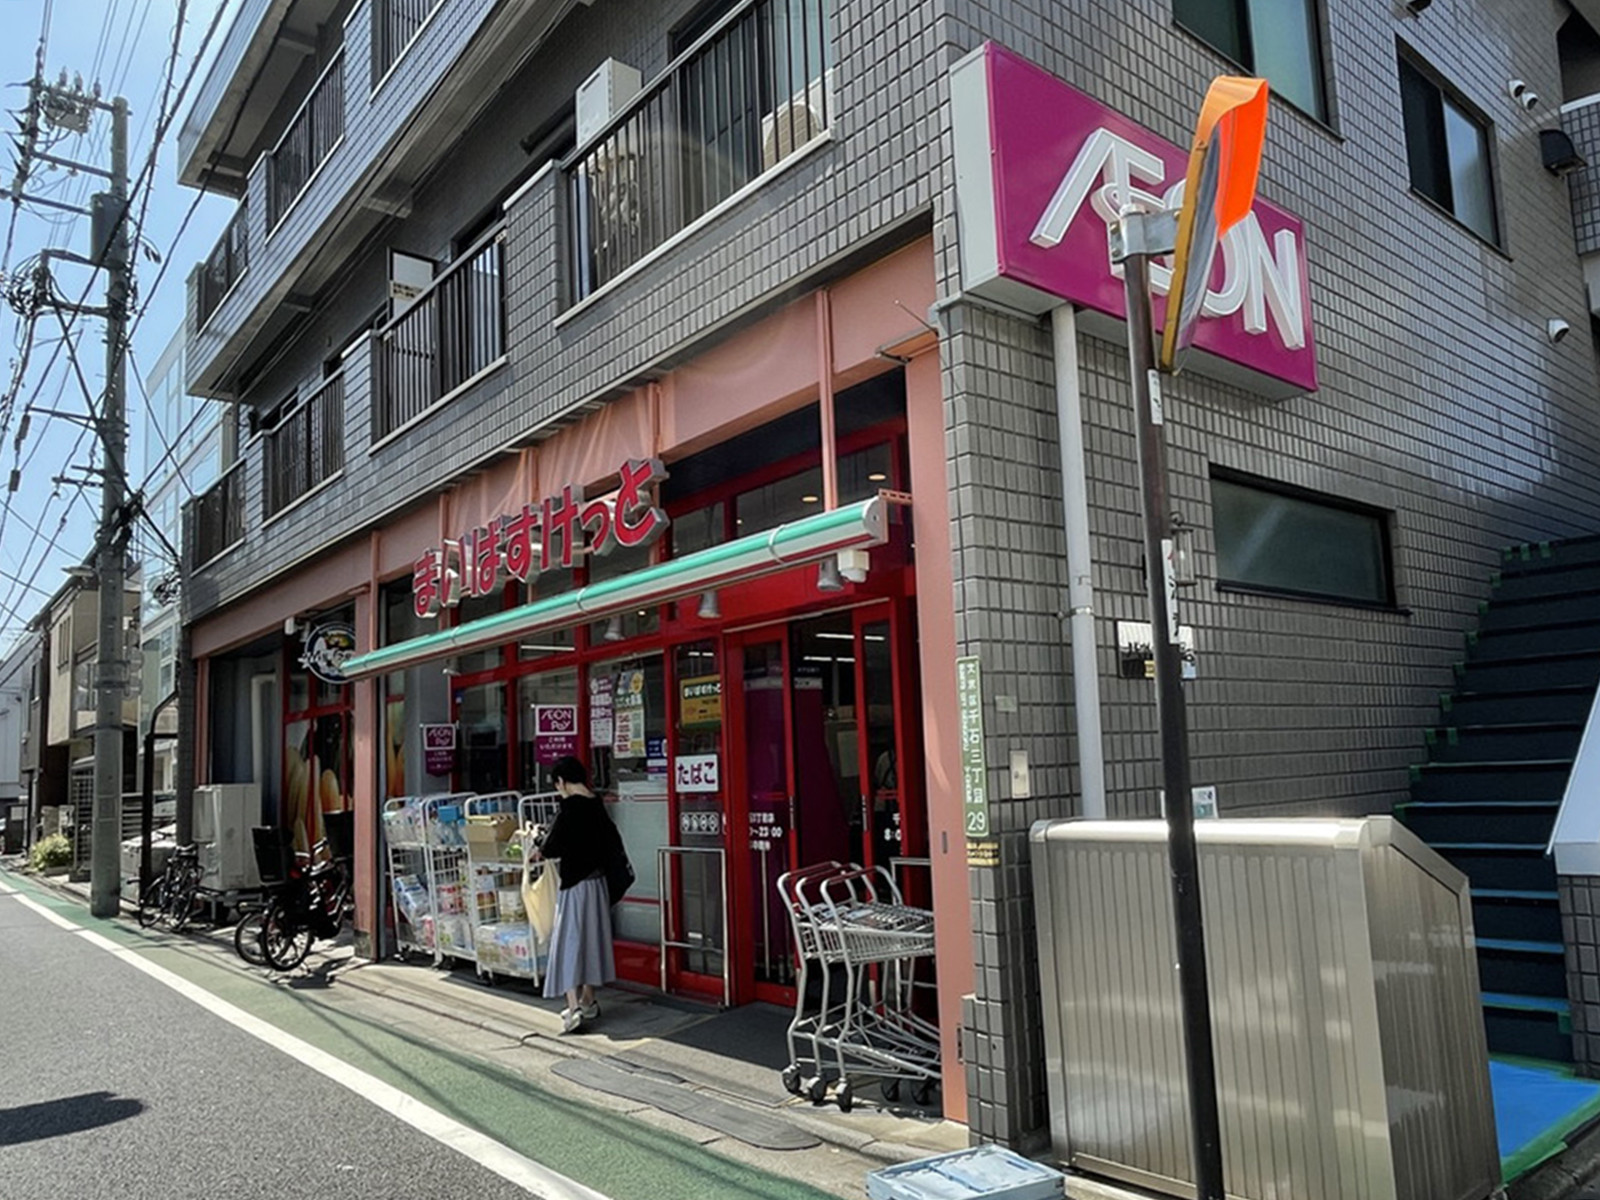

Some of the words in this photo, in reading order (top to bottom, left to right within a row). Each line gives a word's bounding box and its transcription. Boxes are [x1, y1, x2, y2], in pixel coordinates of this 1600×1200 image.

[412, 459, 668, 618] まいばすけっと
[677, 762, 716, 785] たばこ
[967, 811, 986, 831] 29
